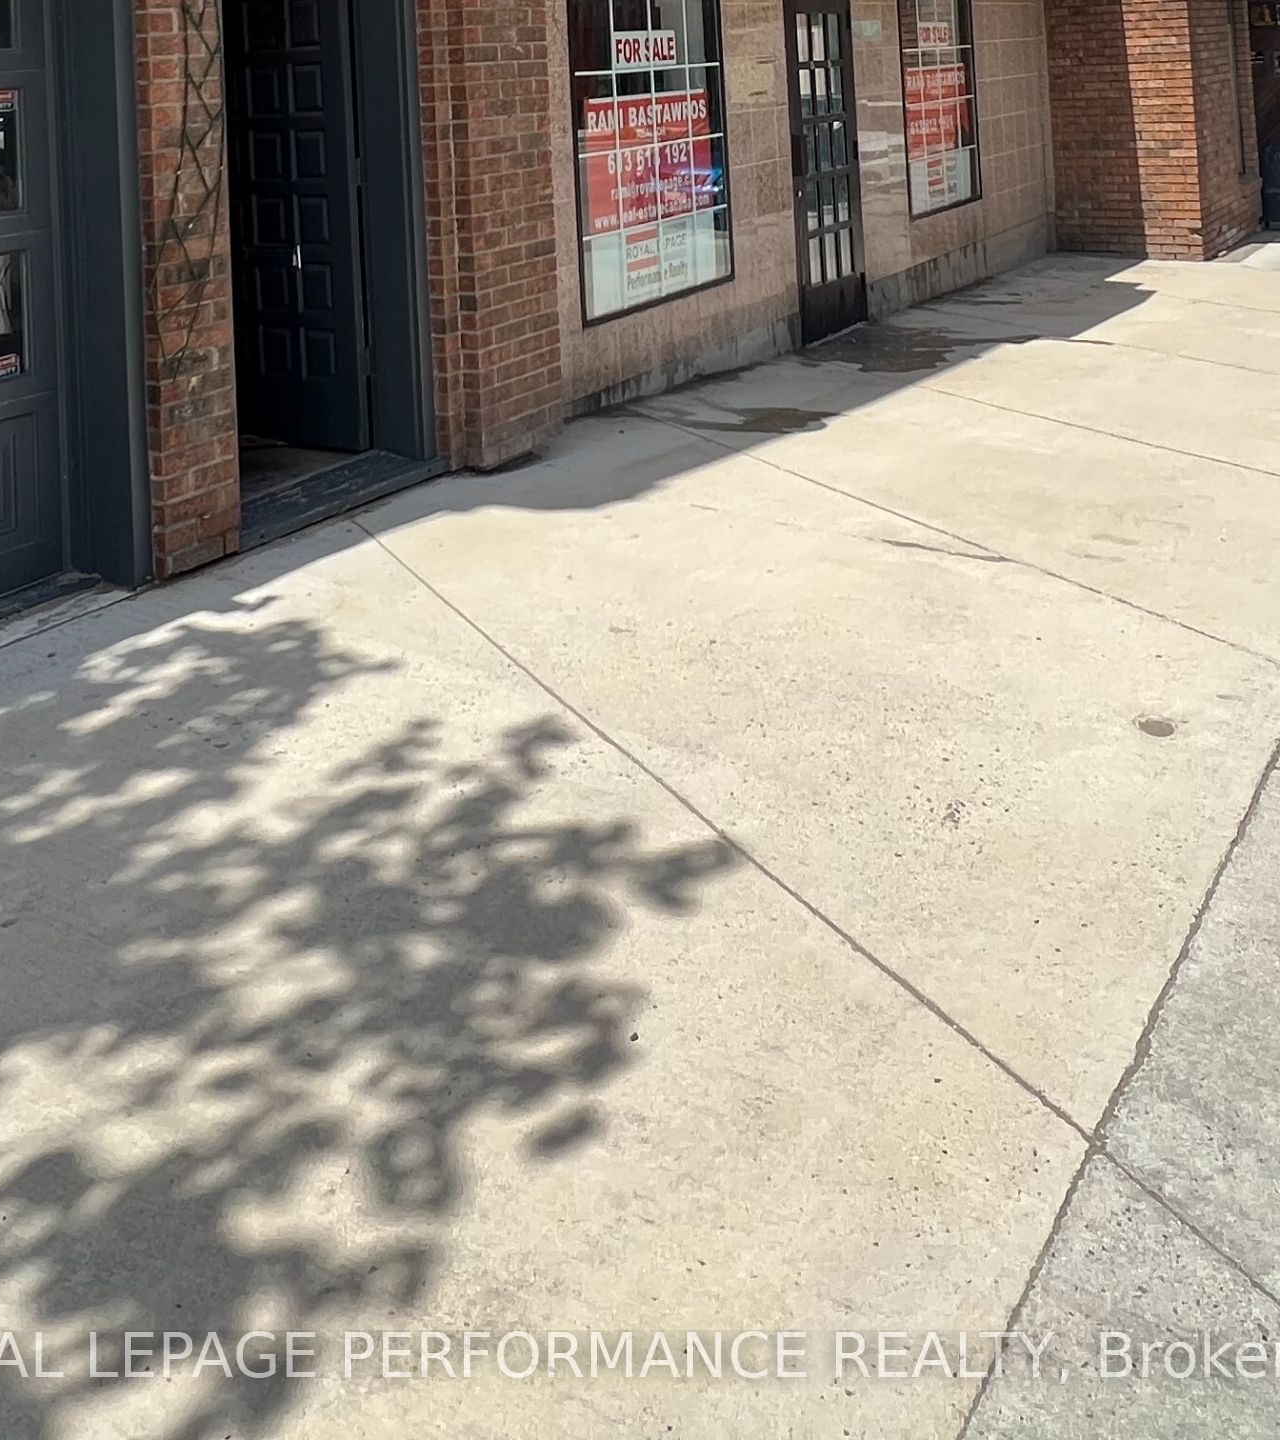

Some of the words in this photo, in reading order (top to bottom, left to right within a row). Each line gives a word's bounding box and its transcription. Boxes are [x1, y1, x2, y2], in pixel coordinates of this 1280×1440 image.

[615, 38, 642, 64] FOR
[644, 36, 675, 62] SALE
[665, 141, 691, 165] 192
[626, 242, 657, 259] ROYAL
